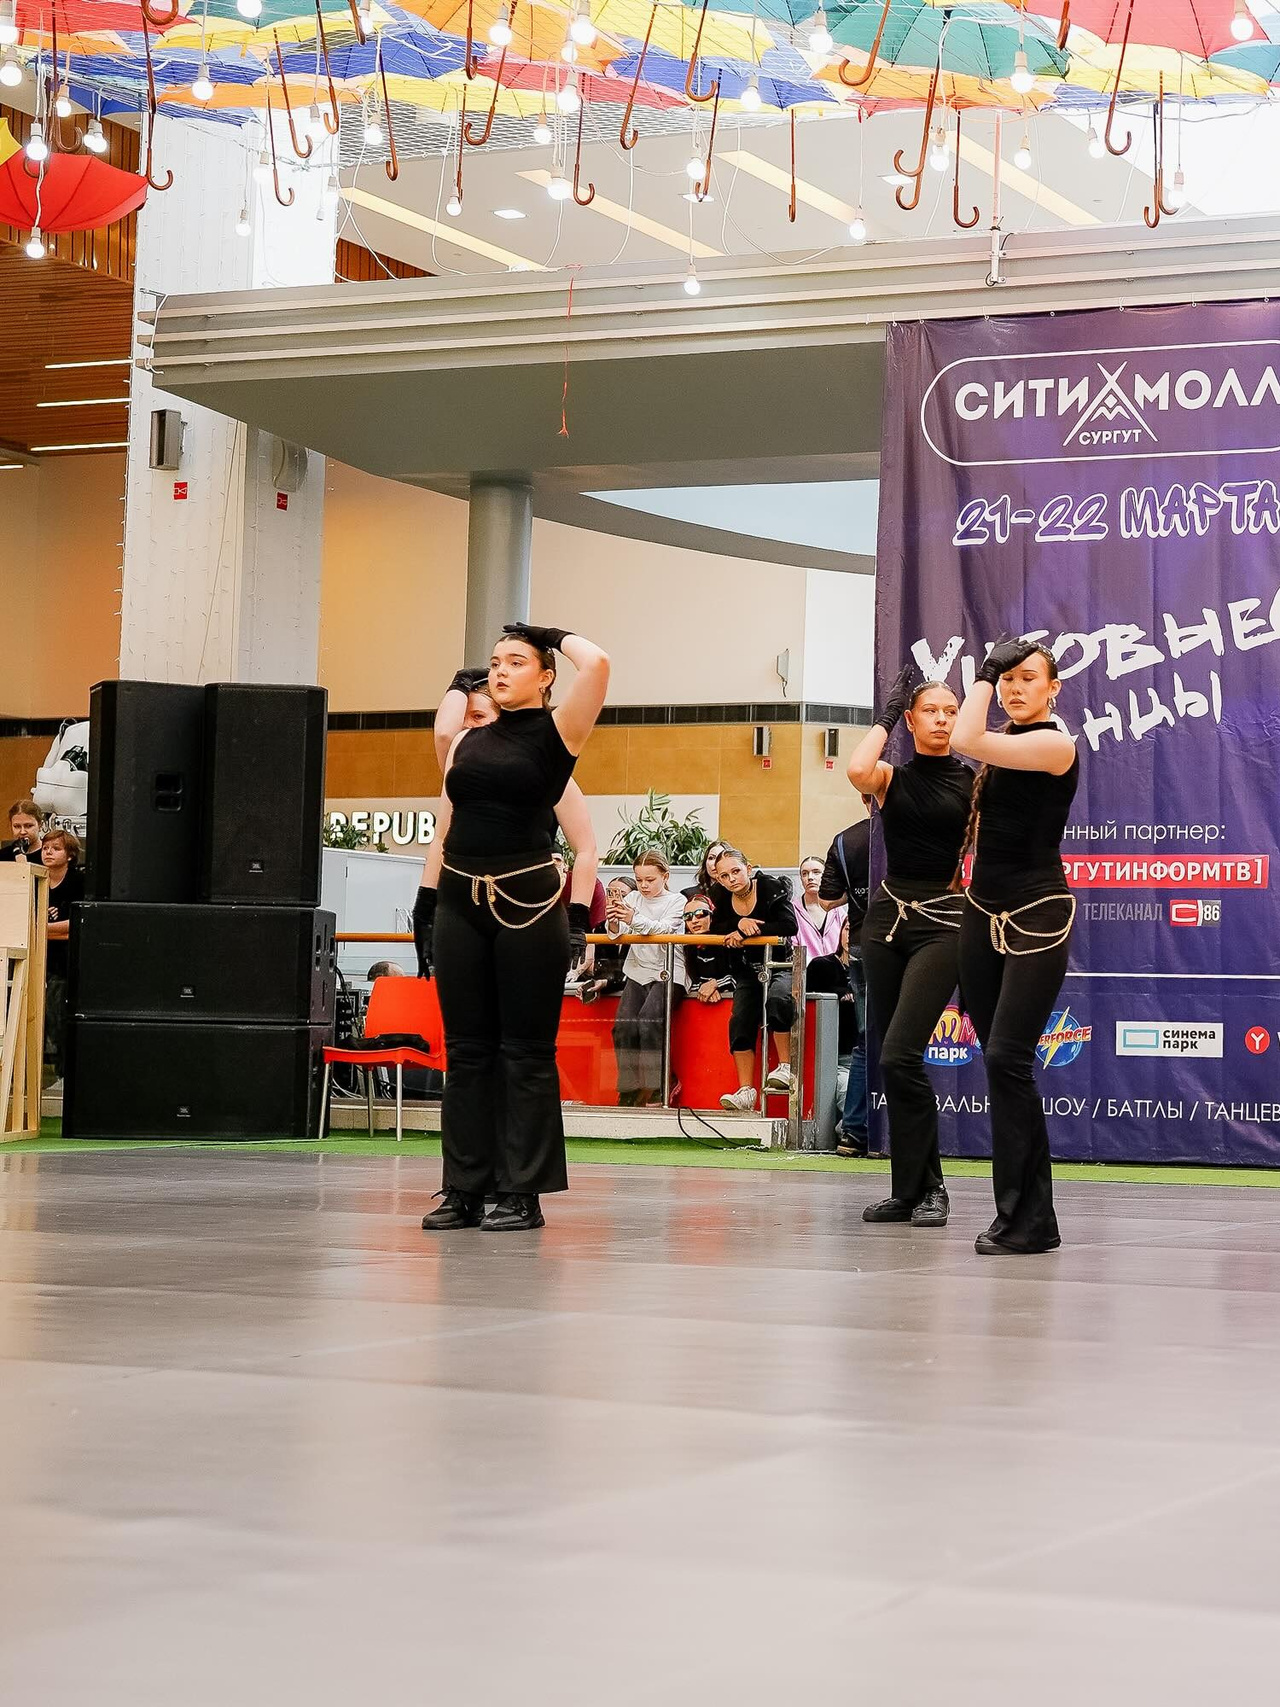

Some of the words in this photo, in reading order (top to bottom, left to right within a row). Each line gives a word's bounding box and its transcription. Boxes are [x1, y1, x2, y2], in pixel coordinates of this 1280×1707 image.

[955, 376, 1089, 421] СИТИ
[1078, 429, 1142, 446] СУРГУТ
[952, 494, 1108, 546] 21-22
[1120, 480, 1280, 539] МАРТА
[1052, 671, 1222, 752] НЦЫ
[330, 811, 435, 844] REPUB
[1063, 820, 1117, 840] нный
[1124, 823, 1226, 845] партнер:
[1062, 859, 1262, 884] РГУТИНФОРМТВ]
[1083, 902, 1163, 921] ТЕЛЕКАНАЛ
[1039, 1026, 1092, 1045] ERFORCE
[1163, 1030, 1216, 1039] синема
[928, 1046, 968, 1062] парк
[1163, 1040, 1199, 1052] парк
[1107, 1099, 1183, 1118] БАТТЛЫ
